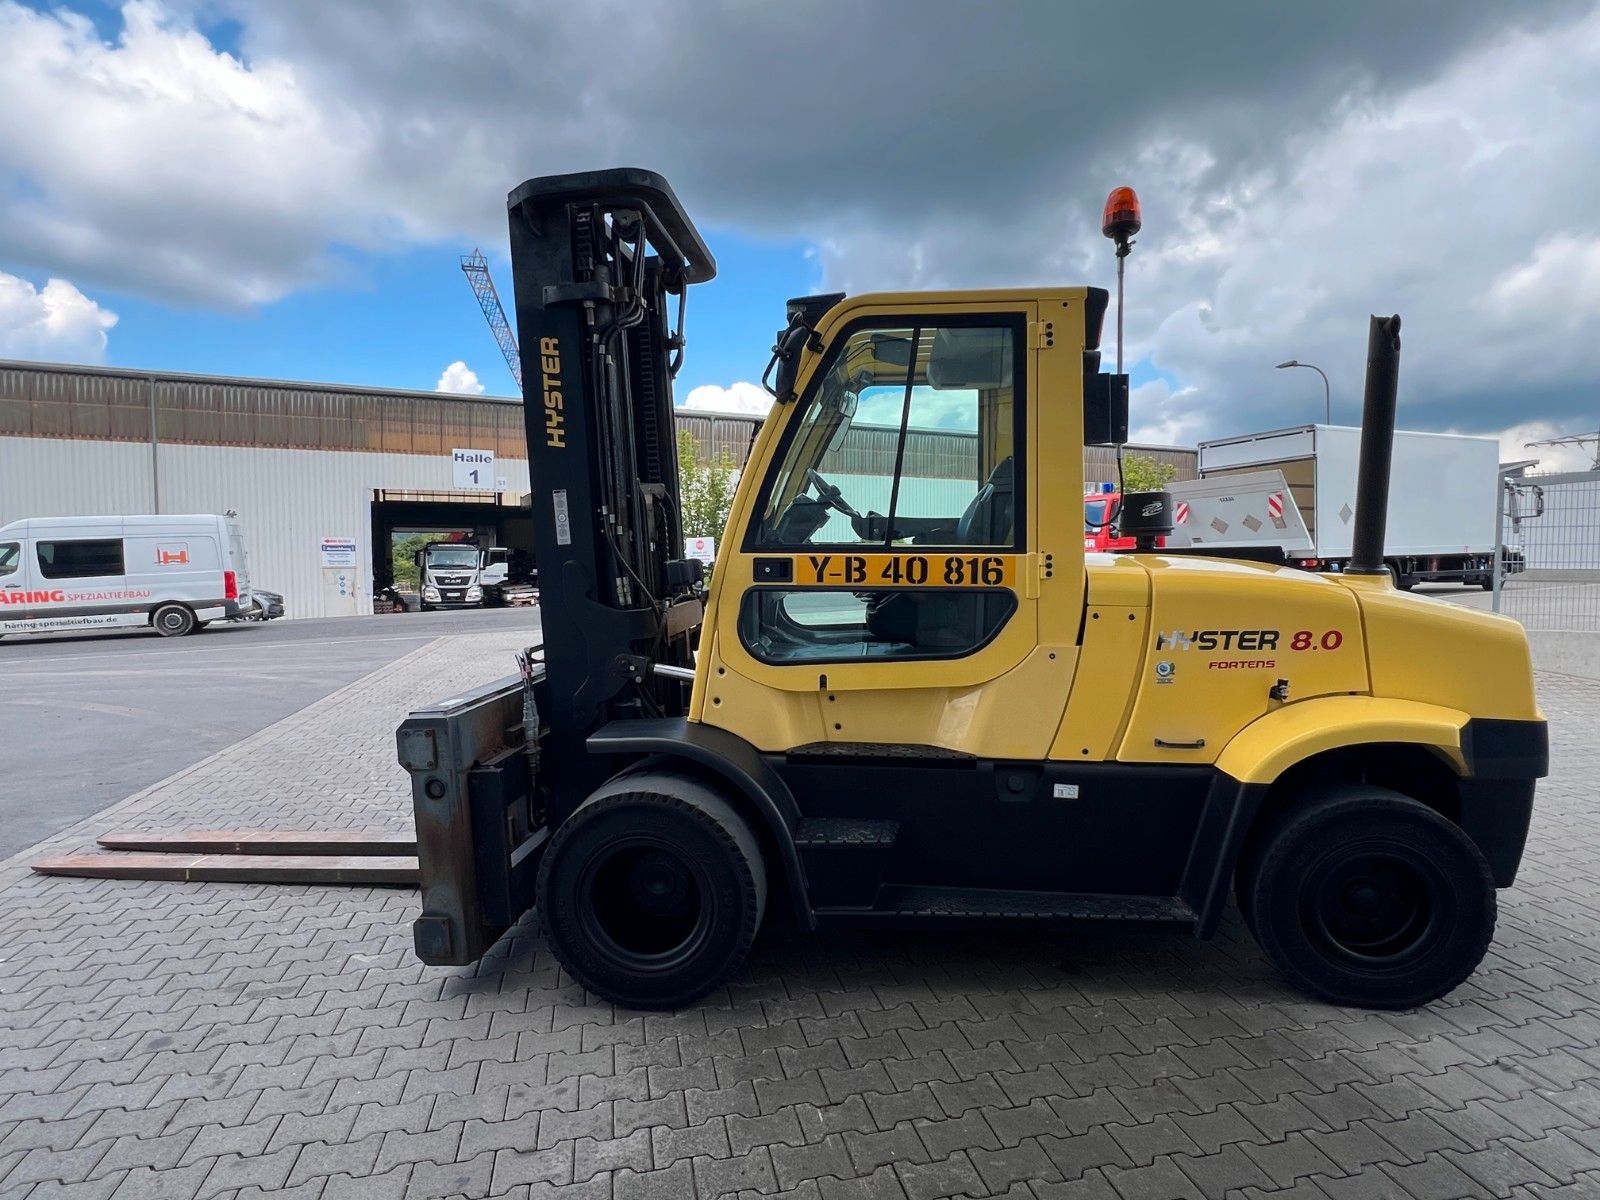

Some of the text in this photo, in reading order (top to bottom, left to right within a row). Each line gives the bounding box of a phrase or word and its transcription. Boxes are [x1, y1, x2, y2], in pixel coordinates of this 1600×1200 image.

[540, 337, 566, 448] HYSTER
[454, 453, 493, 464] Halle
[469, 469, 479, 484] 1
[808, 556, 1004, 585] Y-B 40 816
[66, 589, 151, 601] SPEZIALTIEFBAU
[1155, 630, 1343, 651] HYSTER 8.0
[1208, 660, 1276, 670] FORTENS
